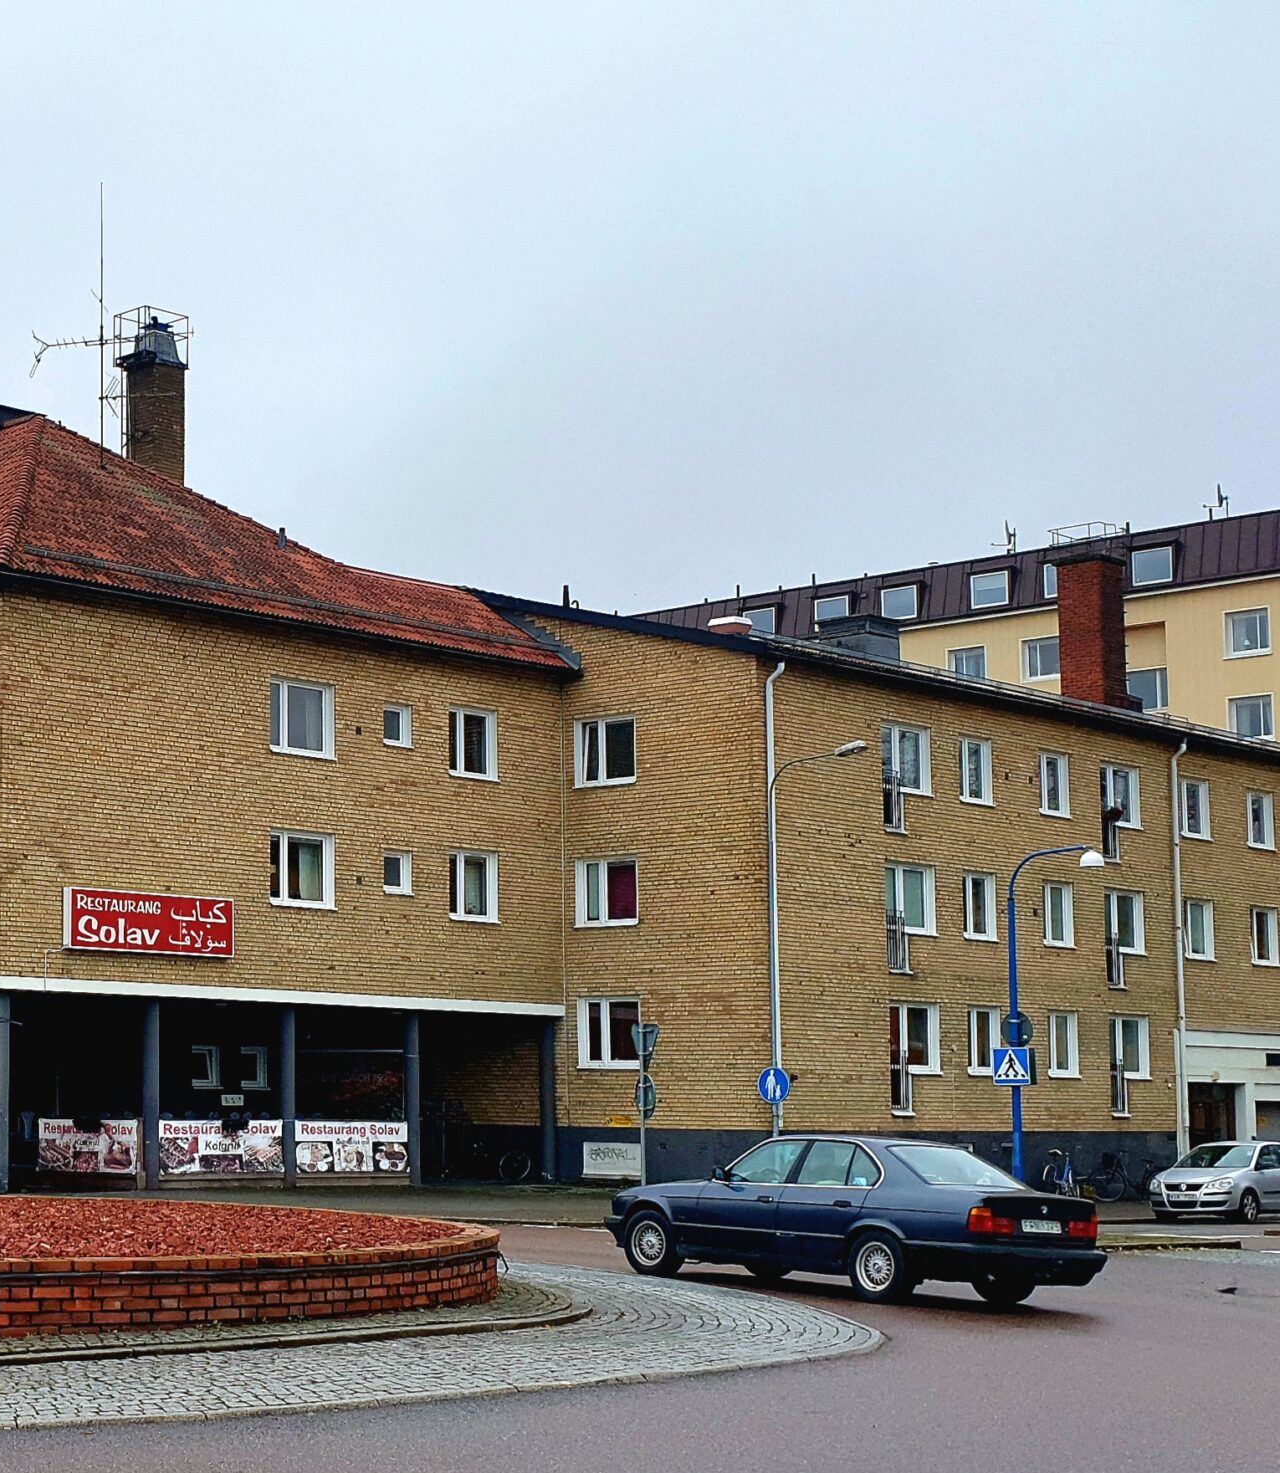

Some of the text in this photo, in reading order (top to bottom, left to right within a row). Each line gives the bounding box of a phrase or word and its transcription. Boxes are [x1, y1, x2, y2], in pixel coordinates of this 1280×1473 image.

[76, 893, 161, 915] RESTAURANG
[76, 915, 160, 946] Solav
[301, 1124, 401, 1137] Restaurang Solav
